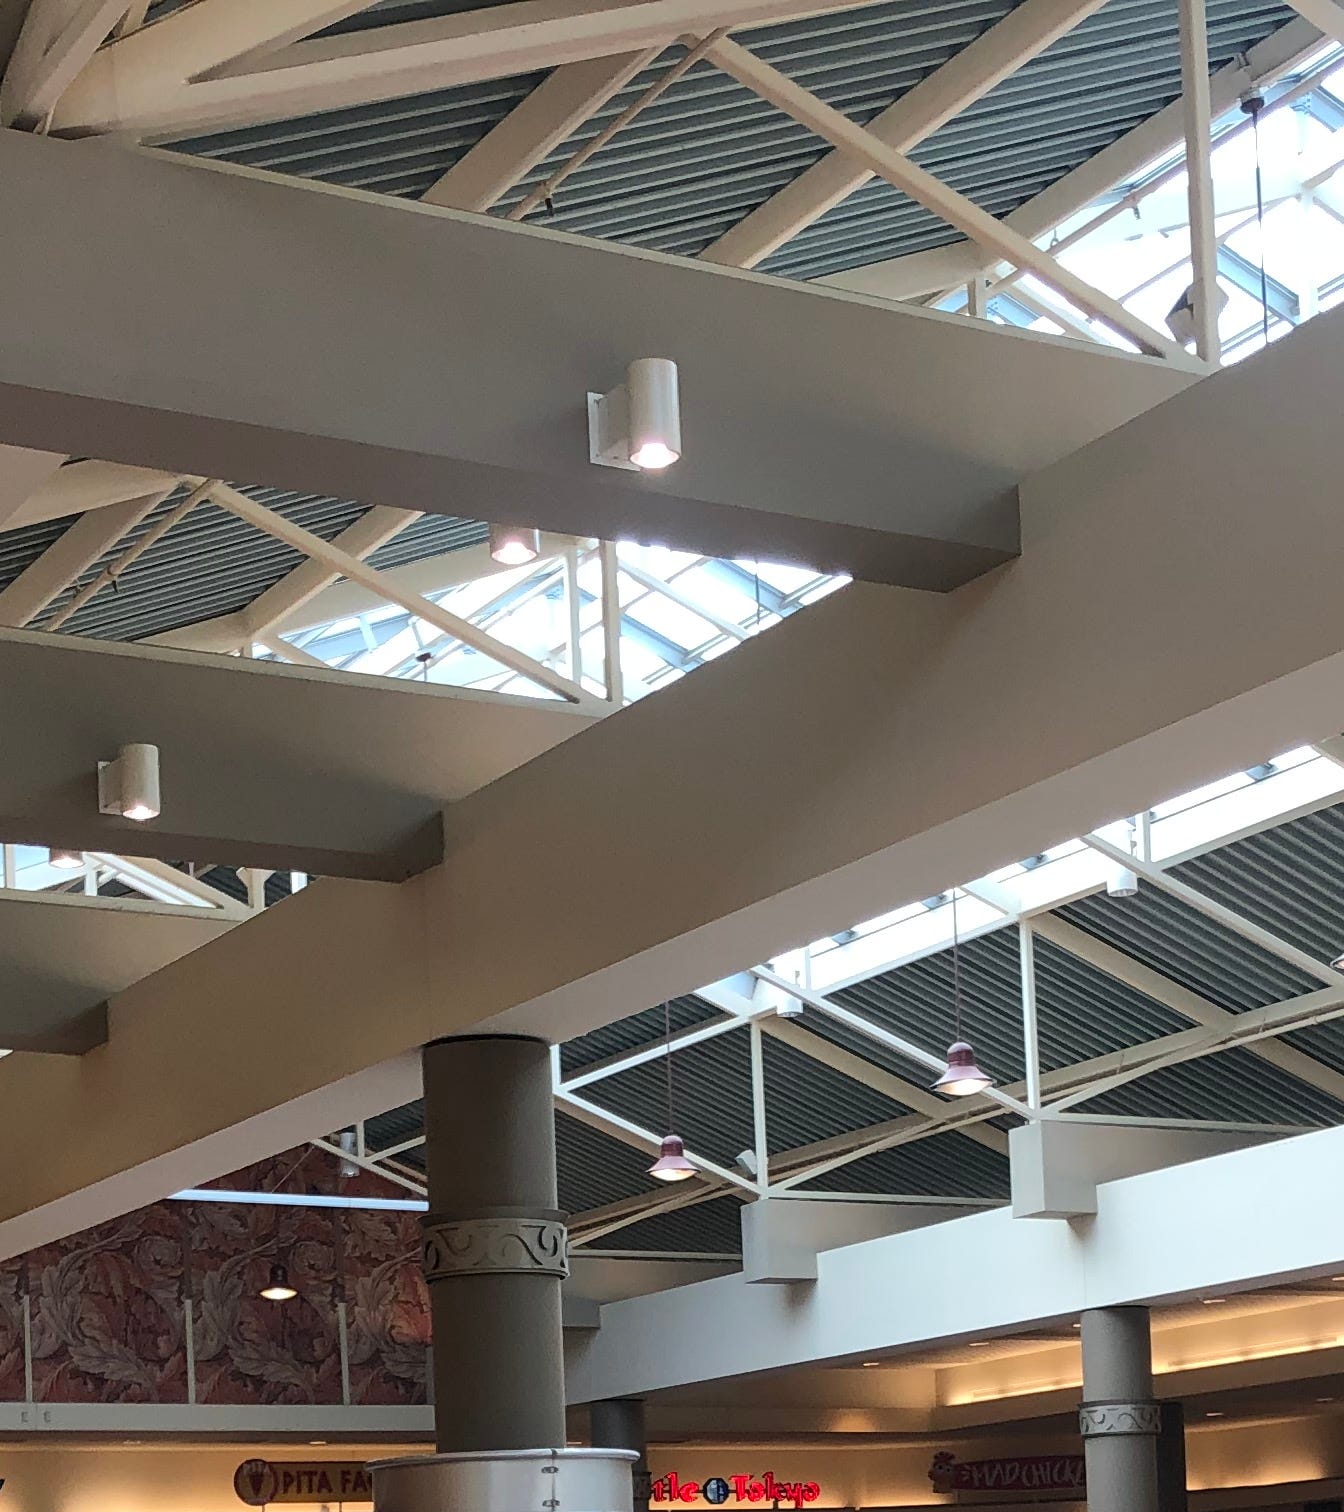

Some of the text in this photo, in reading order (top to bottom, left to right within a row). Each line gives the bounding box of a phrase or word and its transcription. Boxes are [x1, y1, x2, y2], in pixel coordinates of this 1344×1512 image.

[282, 1470, 373, 1494] PITA FA
[729, 1471, 820, 1509] Tokyo
